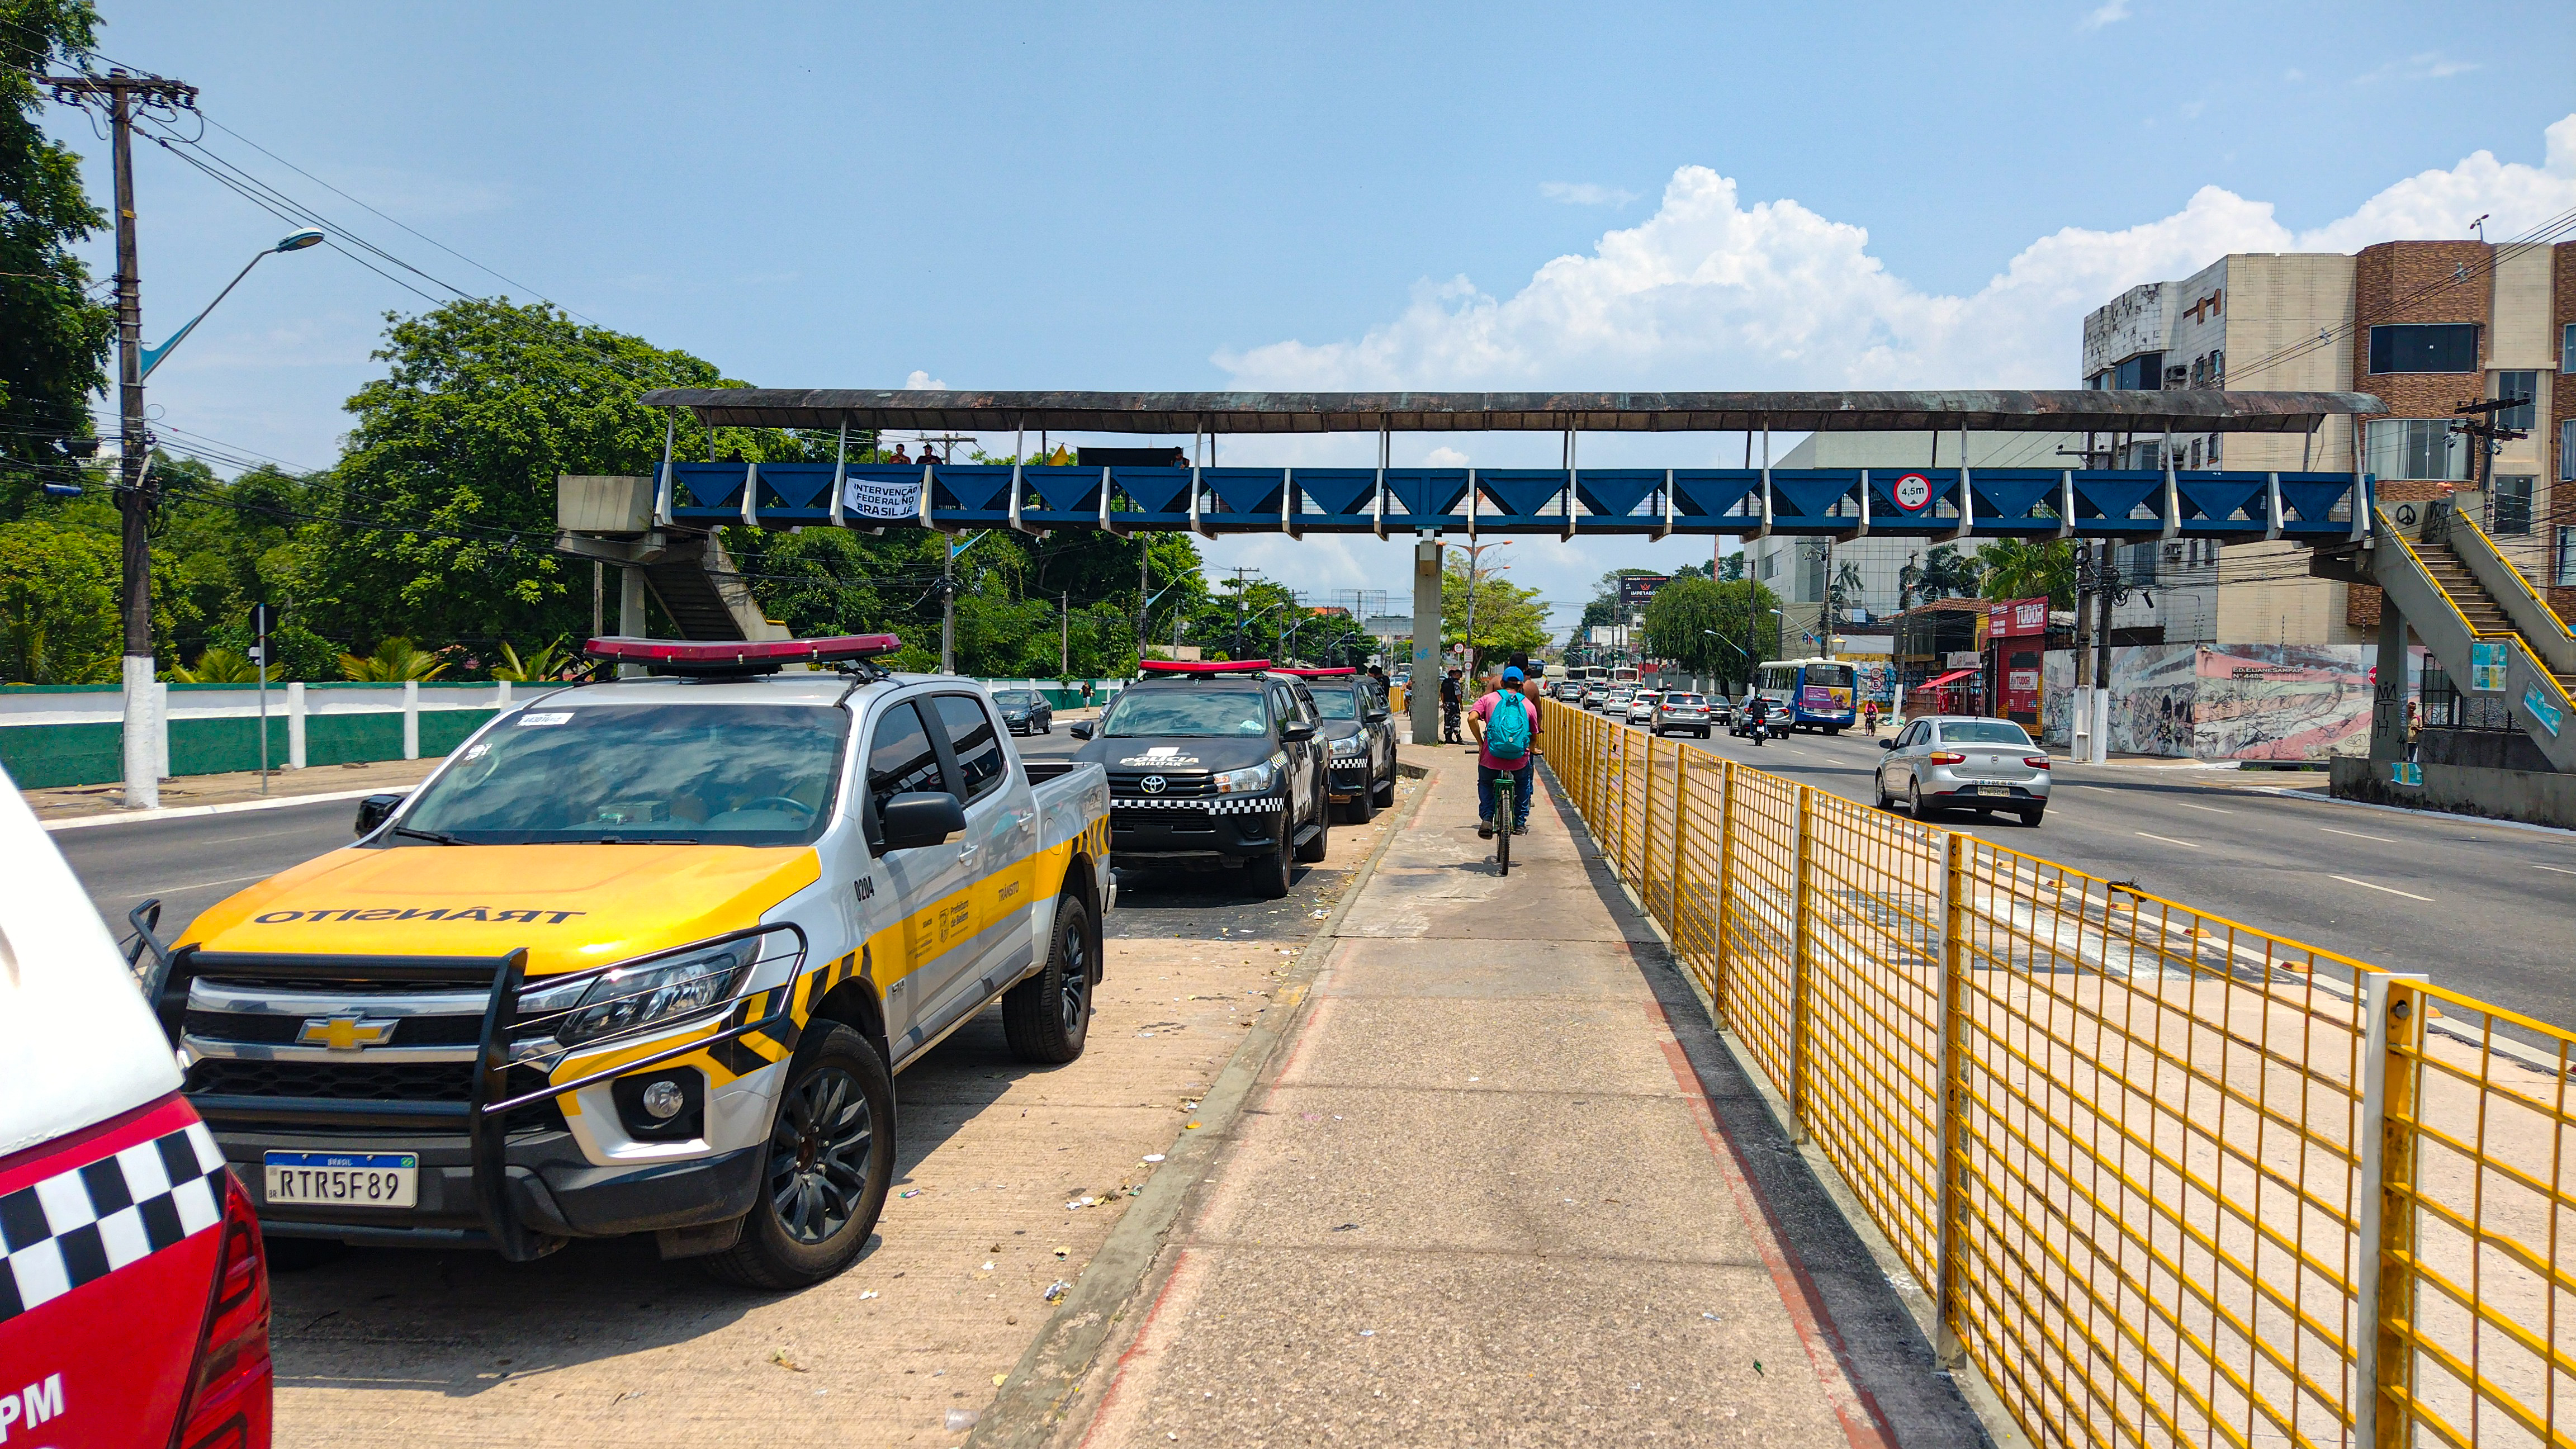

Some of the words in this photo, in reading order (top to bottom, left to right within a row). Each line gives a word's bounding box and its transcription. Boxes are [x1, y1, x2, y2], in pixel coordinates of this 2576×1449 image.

[854, 483, 917, 497] INTERVENÇÃO
[1901, 487, 1924, 497] 4,5m
[856, 493, 899, 505] FEDERAL
[902, 496, 914, 505] NO
[857, 503, 898, 516] BRASIL
[900, 503, 912, 515] JÁ
[2015, 603, 2044, 624] TUDOR
[854, 875, 875, 902] 0204
[327, 1158, 353, 1166] BRASIL
[281, 1169, 399, 1200] RTR5F89
[268, 1189, 278, 1199] BR
